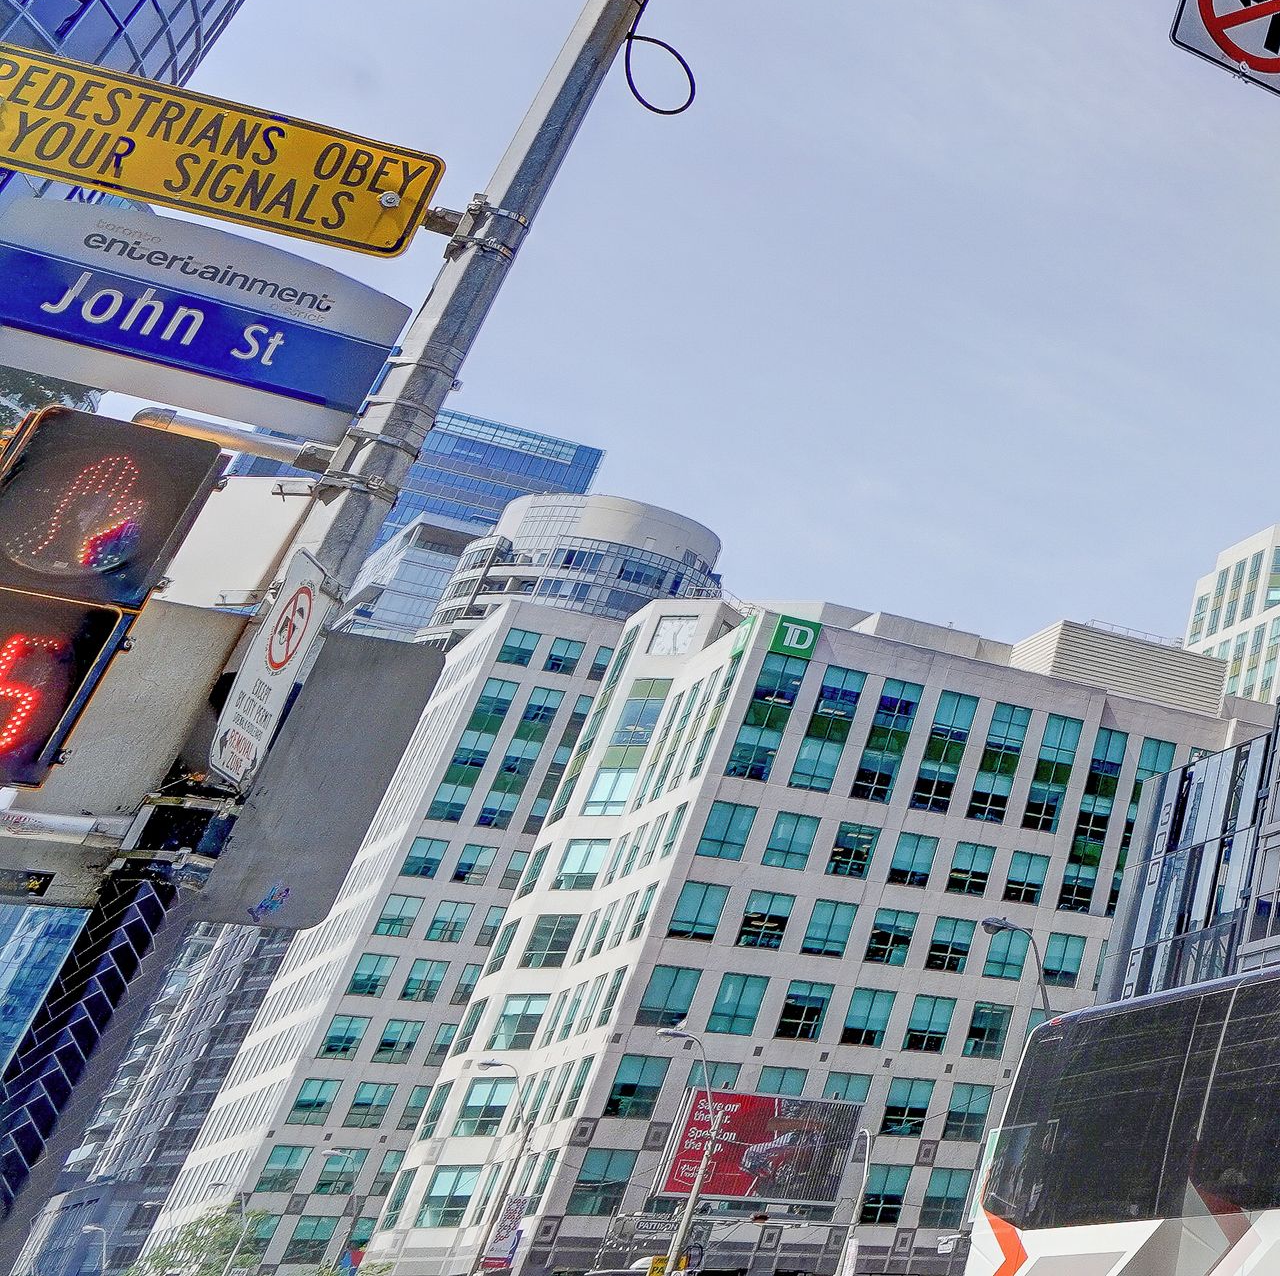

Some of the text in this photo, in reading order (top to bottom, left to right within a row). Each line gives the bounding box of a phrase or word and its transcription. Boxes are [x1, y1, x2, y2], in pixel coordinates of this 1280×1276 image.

[8, 111, 354, 230] YOUR SIGNALS
[313, 142, 427, 197] OBEY
[83, 232, 336, 312] entertainment
[41, 271, 285, 366] John St
[782, 621, 815, 650] TD
